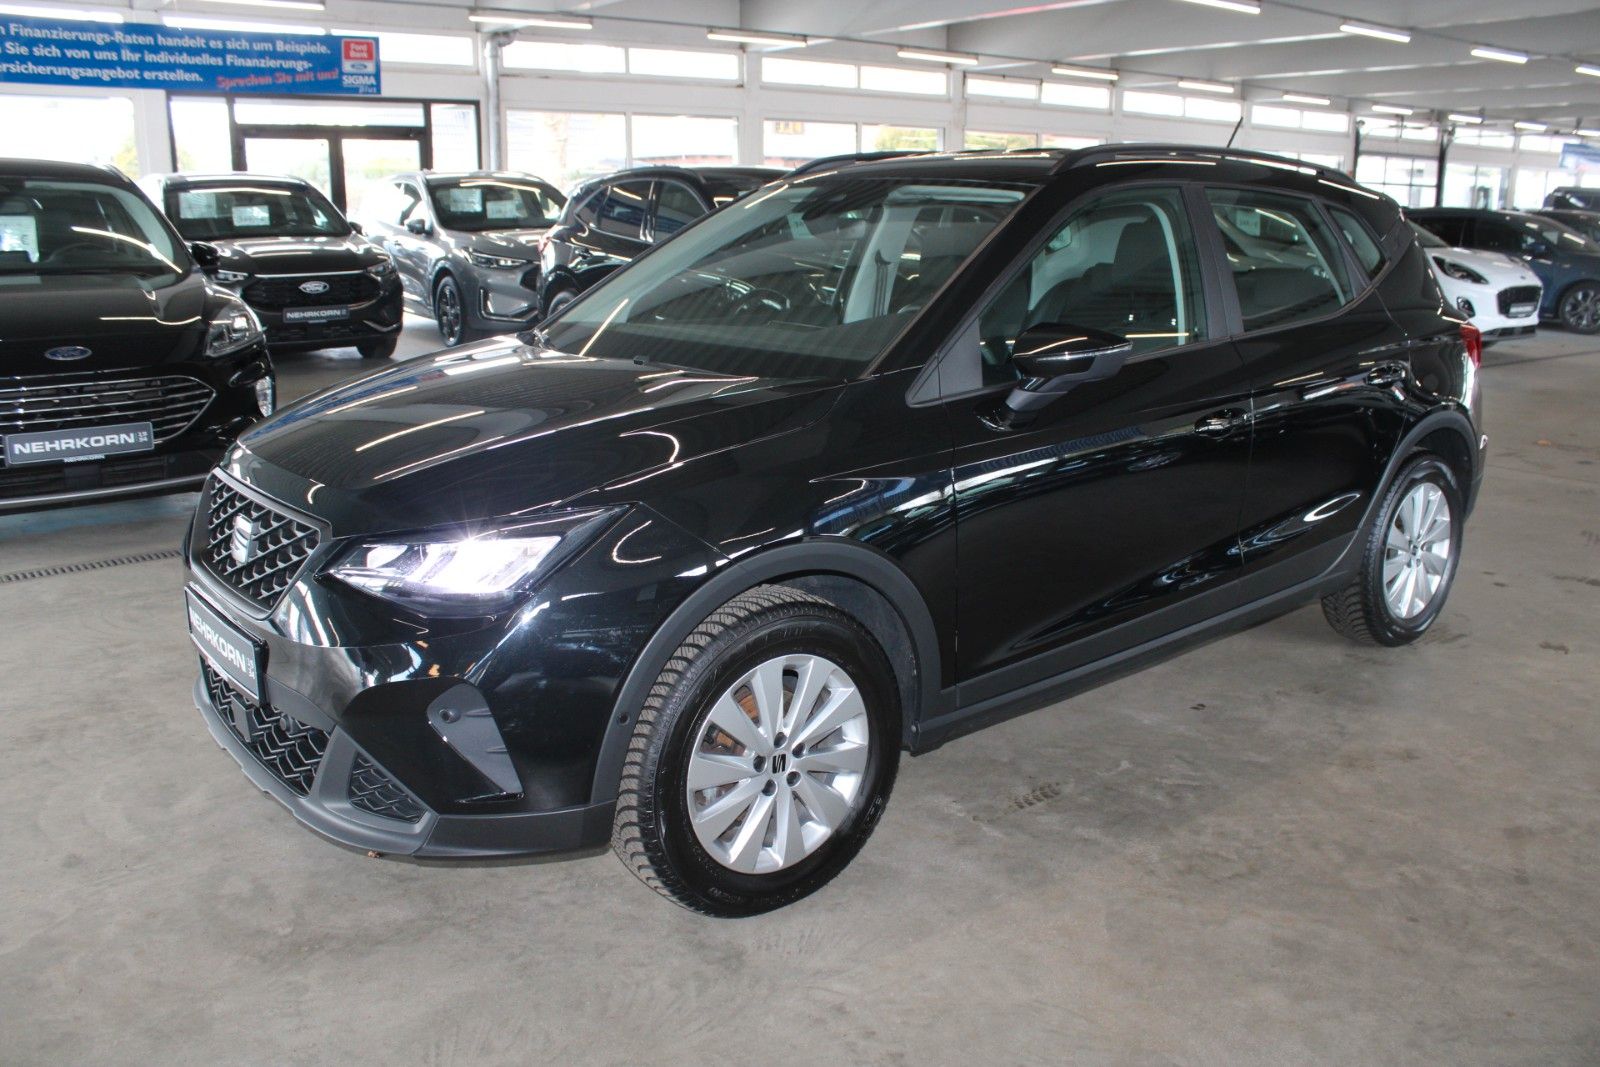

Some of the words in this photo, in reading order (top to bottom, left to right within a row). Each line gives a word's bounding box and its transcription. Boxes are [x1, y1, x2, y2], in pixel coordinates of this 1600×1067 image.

[9, 22, 154, 46] Finanzierungs-Raten
[157, 33, 206, 49] handelt
[209, 40, 223, 50] es
[226, 38, 249, 51] sich
[253, 43, 273, 52] um
[276, 40, 331, 56] Beispiele.
[5, 41, 29, 56] Sie
[33, 43, 61, 58] sich
[64, 48, 90, 60] von
[93, 49, 118, 61] uns
[121, 48, 141, 62] Ihr
[144, 49, 223, 66] individuelles
[226, 54, 313, 73] Finanzierungs-
[143, 68, 203, 82] erstellen.
[342, 75, 377, 86] SIGMA
[286, 309, 341, 319] NEHRKORN
[13, 432, 135, 454] NEHRKORN
[188, 606, 247, 673] NEHRKORN
